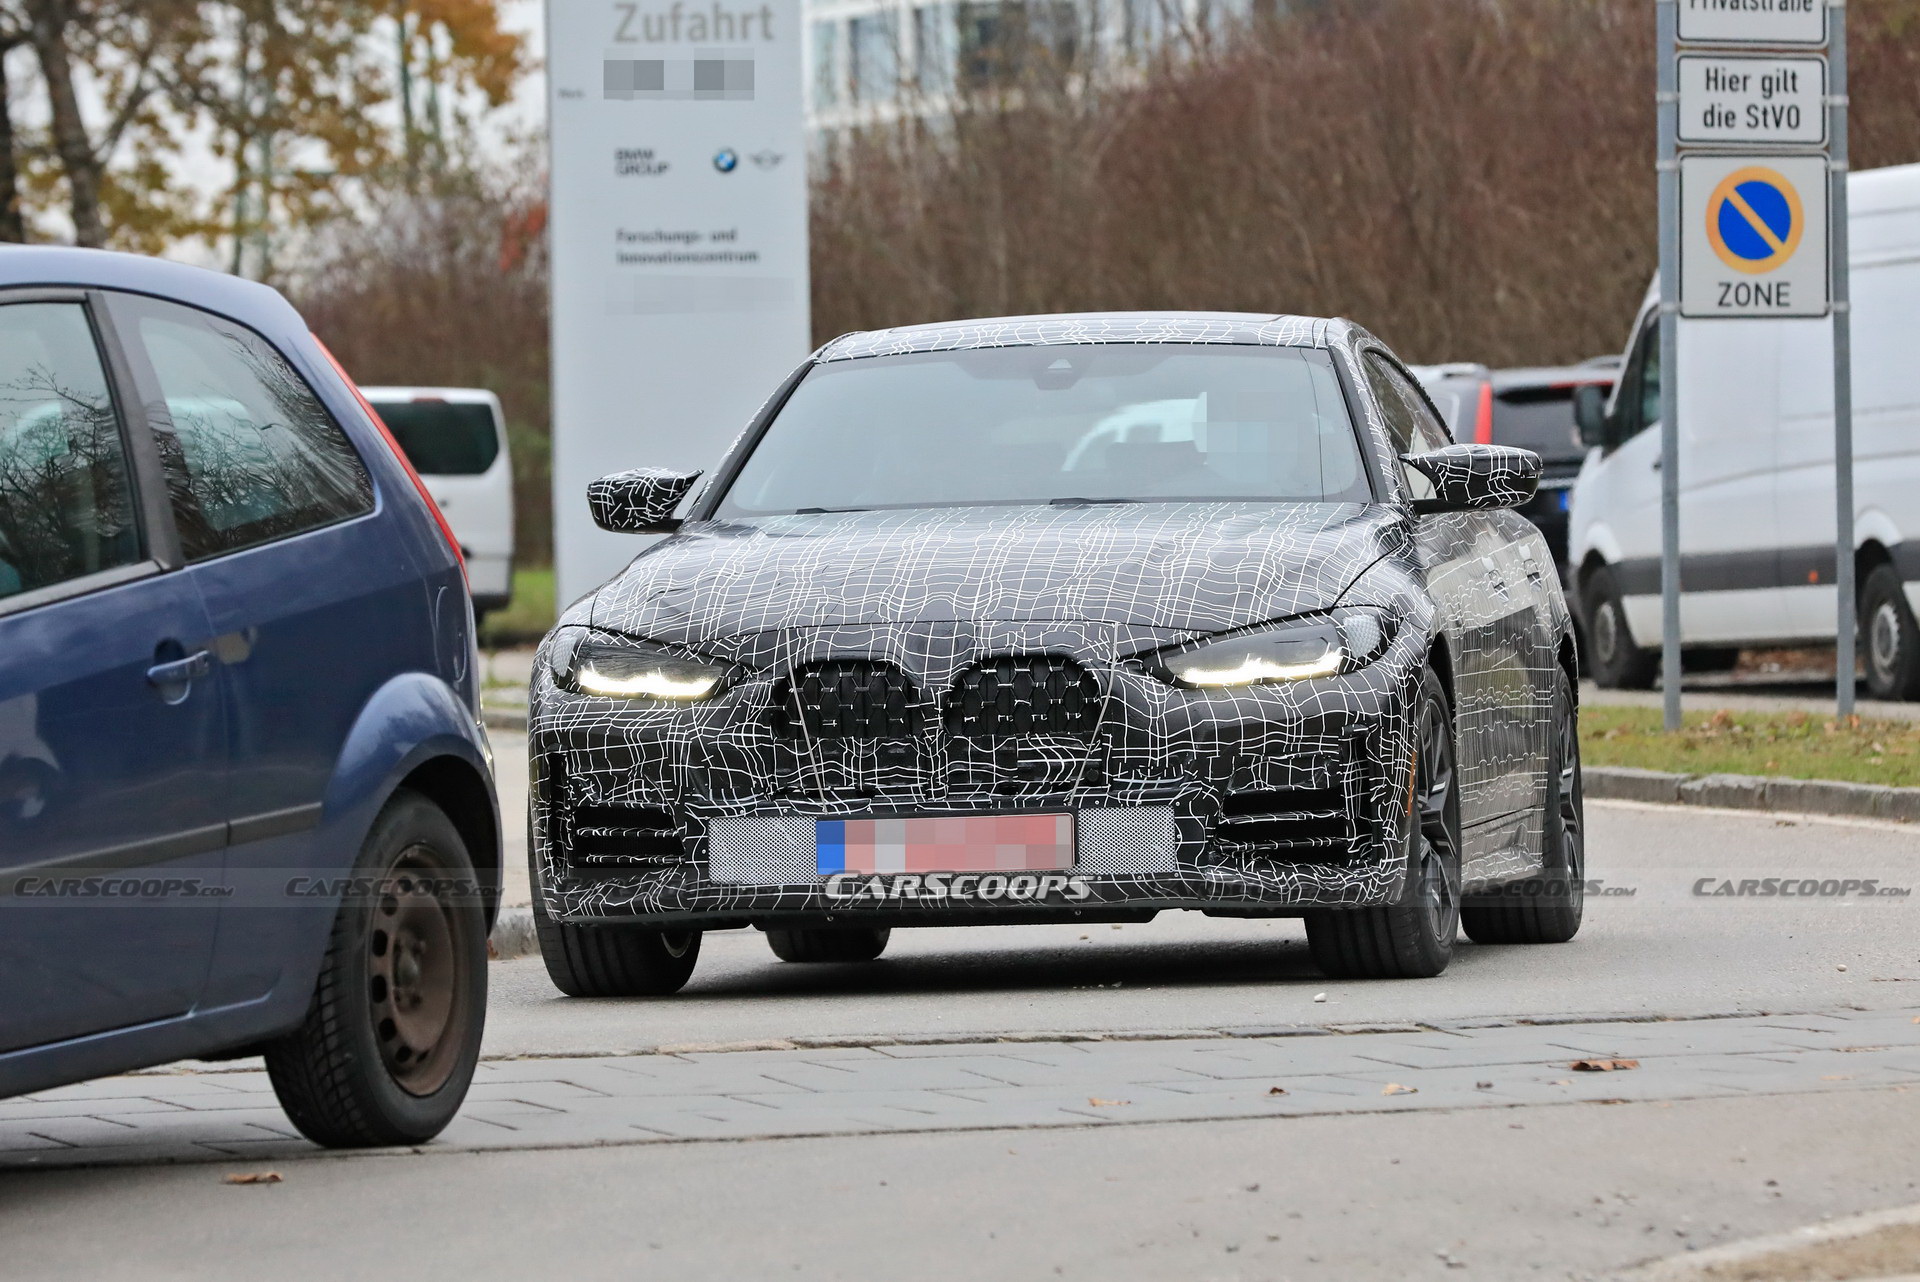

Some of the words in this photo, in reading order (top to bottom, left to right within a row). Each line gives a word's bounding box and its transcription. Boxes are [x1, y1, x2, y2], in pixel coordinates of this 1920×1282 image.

[614, 2, 775, 42] Zufahrt
[1705, 67, 1750, 92] Hier
[1761, 68, 1798, 100] gilt
[1703, 103, 1736, 128] die
[1746, 104, 1800, 129] StVO
[710, 229, 738, 243] und
[1717, 282, 1791, 307] ZONE
